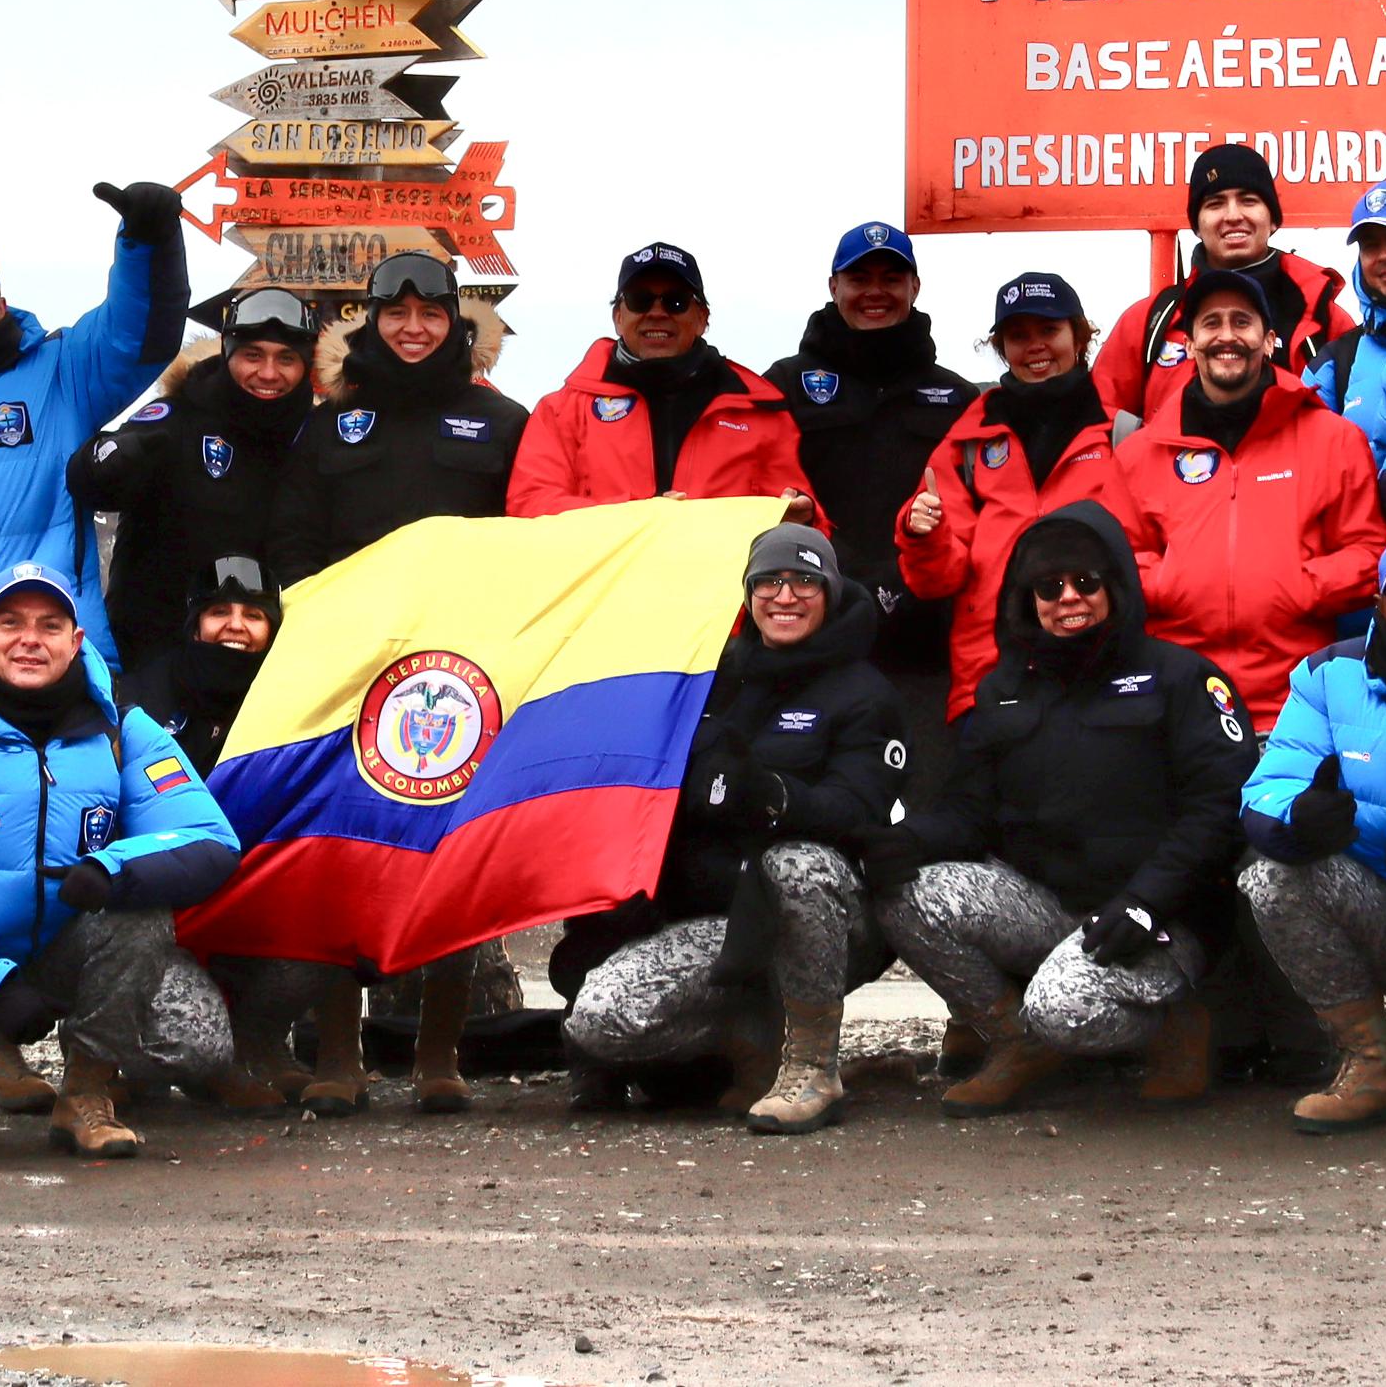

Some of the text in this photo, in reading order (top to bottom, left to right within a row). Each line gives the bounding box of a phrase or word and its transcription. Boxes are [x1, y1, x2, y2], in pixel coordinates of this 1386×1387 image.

[316, 45, 327, 53] LA
[1025, 39, 1171, 91] BASE
[1178, 24, 1359, 90] AÉREA
[286, 69, 374, 90] VALLENAR
[251, 123, 427, 151] SAN ROSENDO
[245, 180, 273, 198] LA
[288, 181, 371, 202] SERENA
[439, 190, 472, 207] KM
[266, 231, 388, 282] CHANCO
[385, 655, 490, 698] REPUBLICA
[364, 747, 480, 795] DE COLOMBIA
